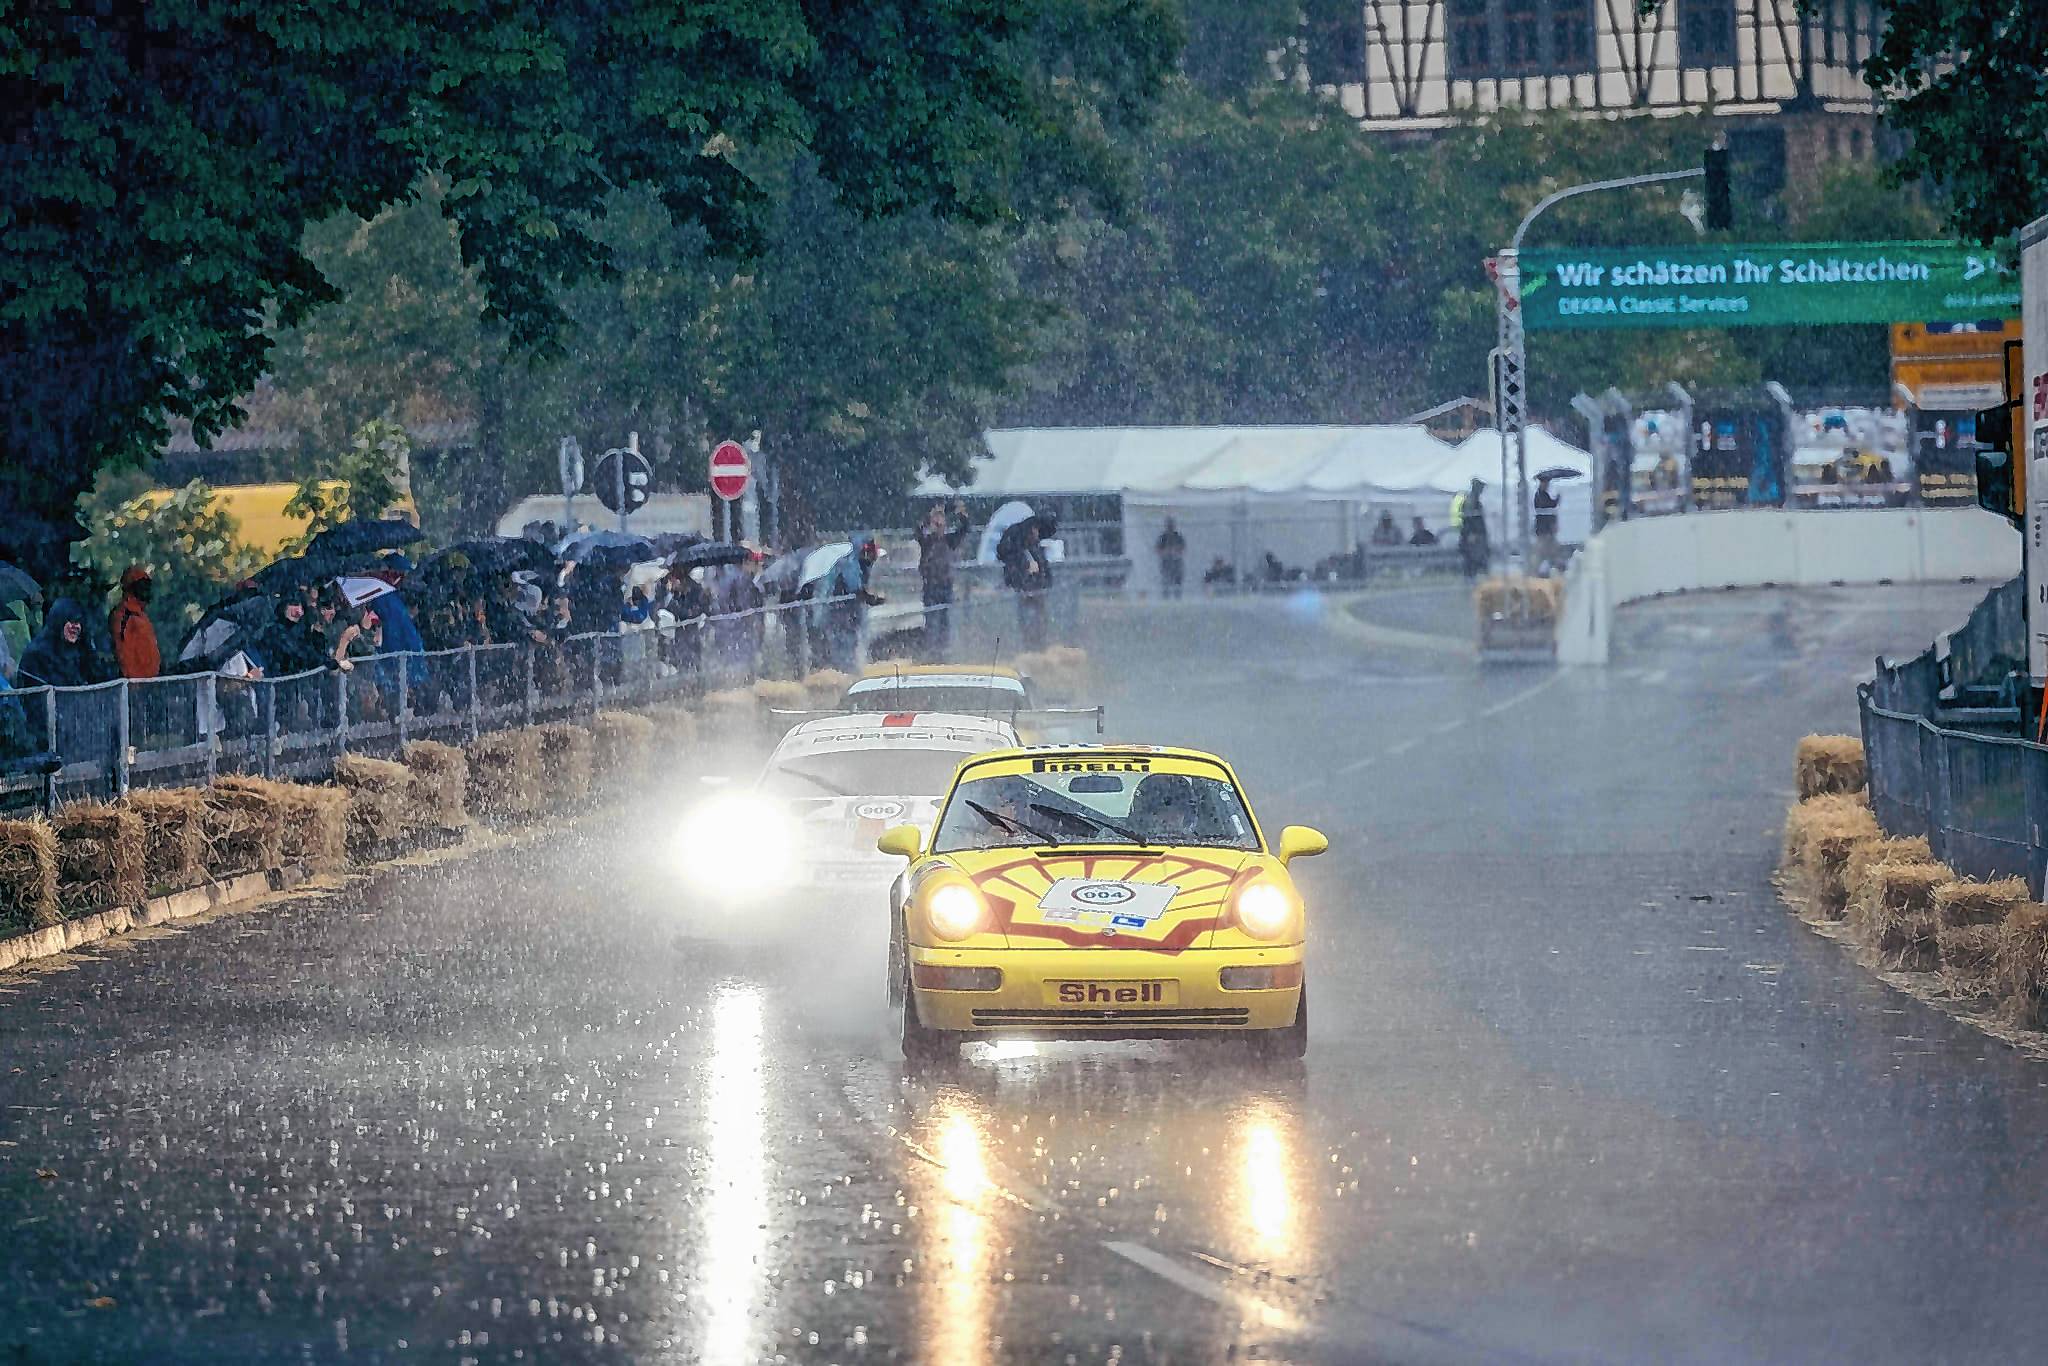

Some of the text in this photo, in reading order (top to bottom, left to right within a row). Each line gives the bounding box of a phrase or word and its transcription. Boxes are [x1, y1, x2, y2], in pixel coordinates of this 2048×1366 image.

[1556, 256, 1929, 286] Wir schätzen Ihr Schätzchen
[812, 732, 974, 744] PORSCHE
[1032, 757, 1151, 773] PIRELLI
[1059, 983, 1162, 1002] Shell
